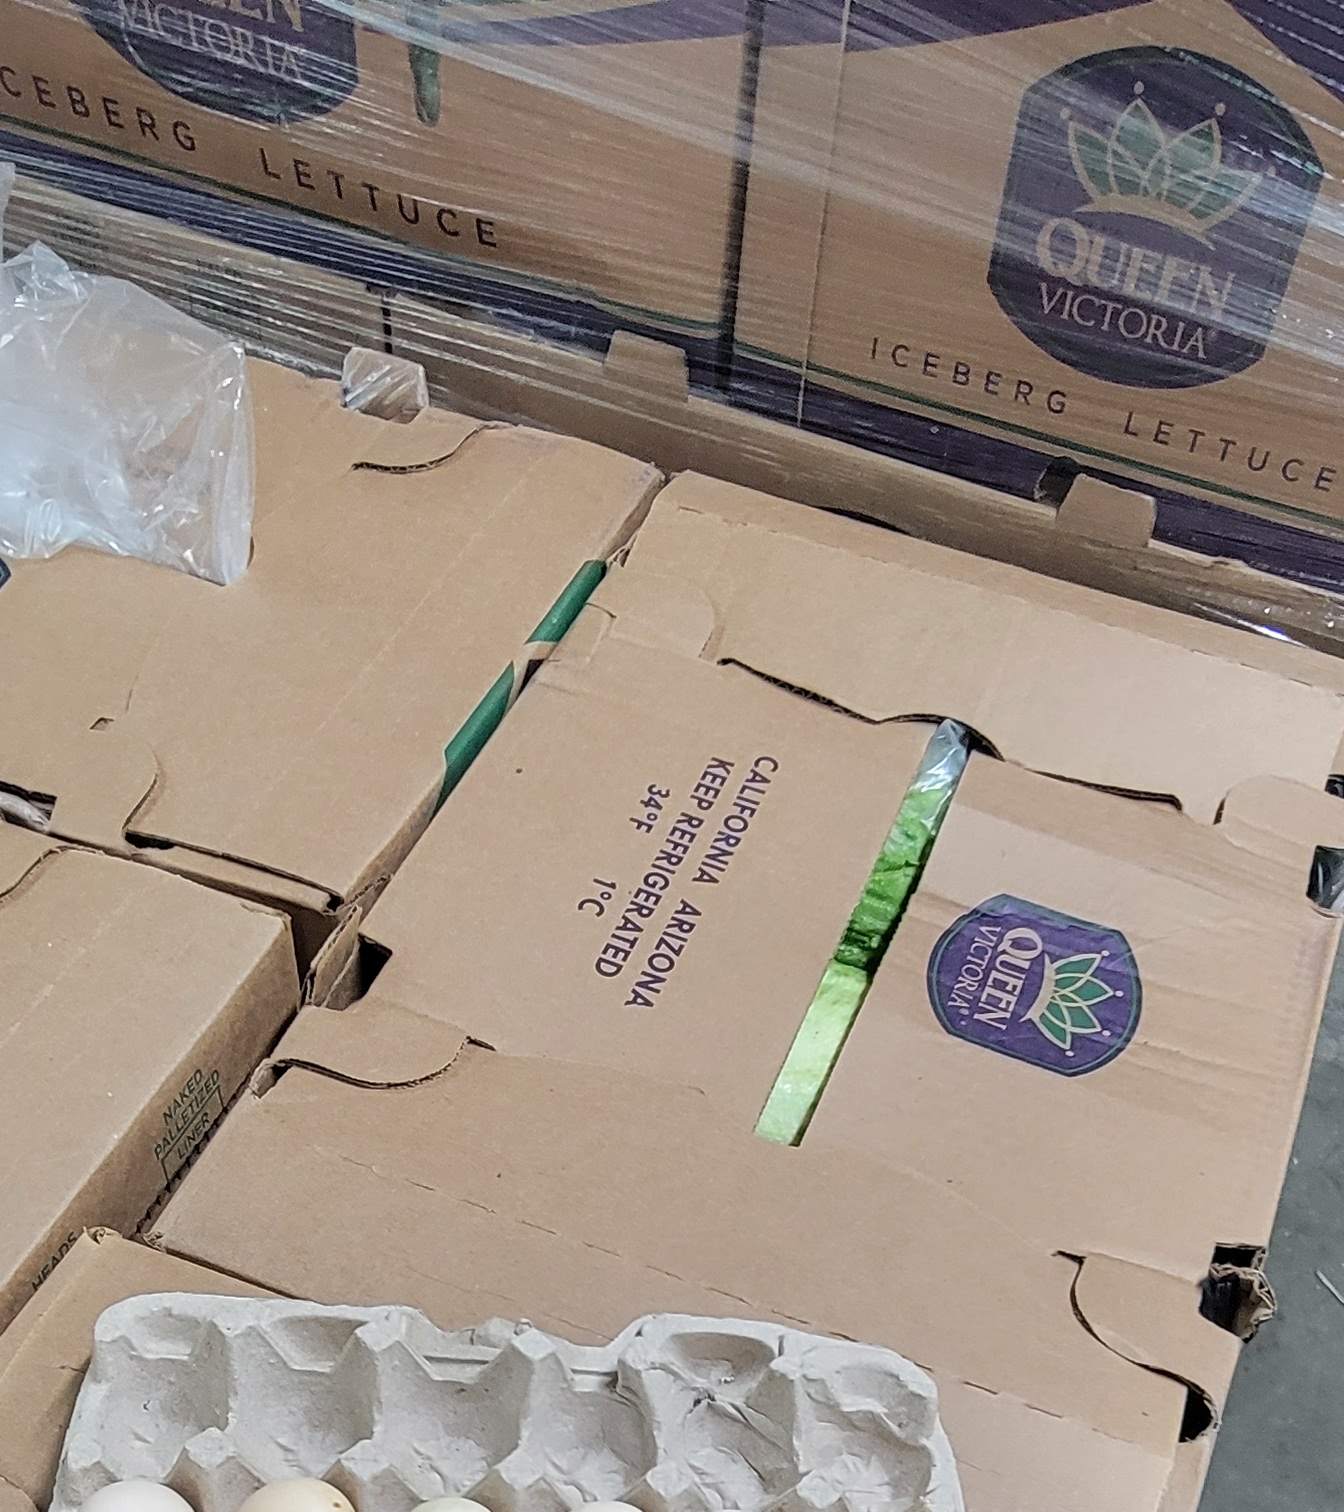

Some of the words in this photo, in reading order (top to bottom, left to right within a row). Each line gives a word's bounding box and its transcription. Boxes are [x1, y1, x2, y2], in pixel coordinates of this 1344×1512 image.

[258, 146, 499, 250] LETTUCE
[1036, 216, 1237, 320] QUEEN
[1038, 281, 1208, 360] VICTORIA
[869, 335, 1068, 415] ICEBERG
[1122, 410, 1339, 493] LETTUCE
[628, 783, 671, 835] 34°F
[689, 756, 736, 812] KEEP
[690, 755, 780, 886] CALIFORNIA
[576, 877, 618, 919] 1°C
[593, 811, 706, 979] REFRIGERATED
[623, 897, 703, 1009] ARIZONA
[947, 924, 1002, 1009] VICTORIA
[972, 926, 1043, 1031] QUEEN
[153, 1068, 221, 1161] PALLETIZED
[162, 1068, 204, 1126] NAKED
[177, 1111, 212, 1161] LINER
